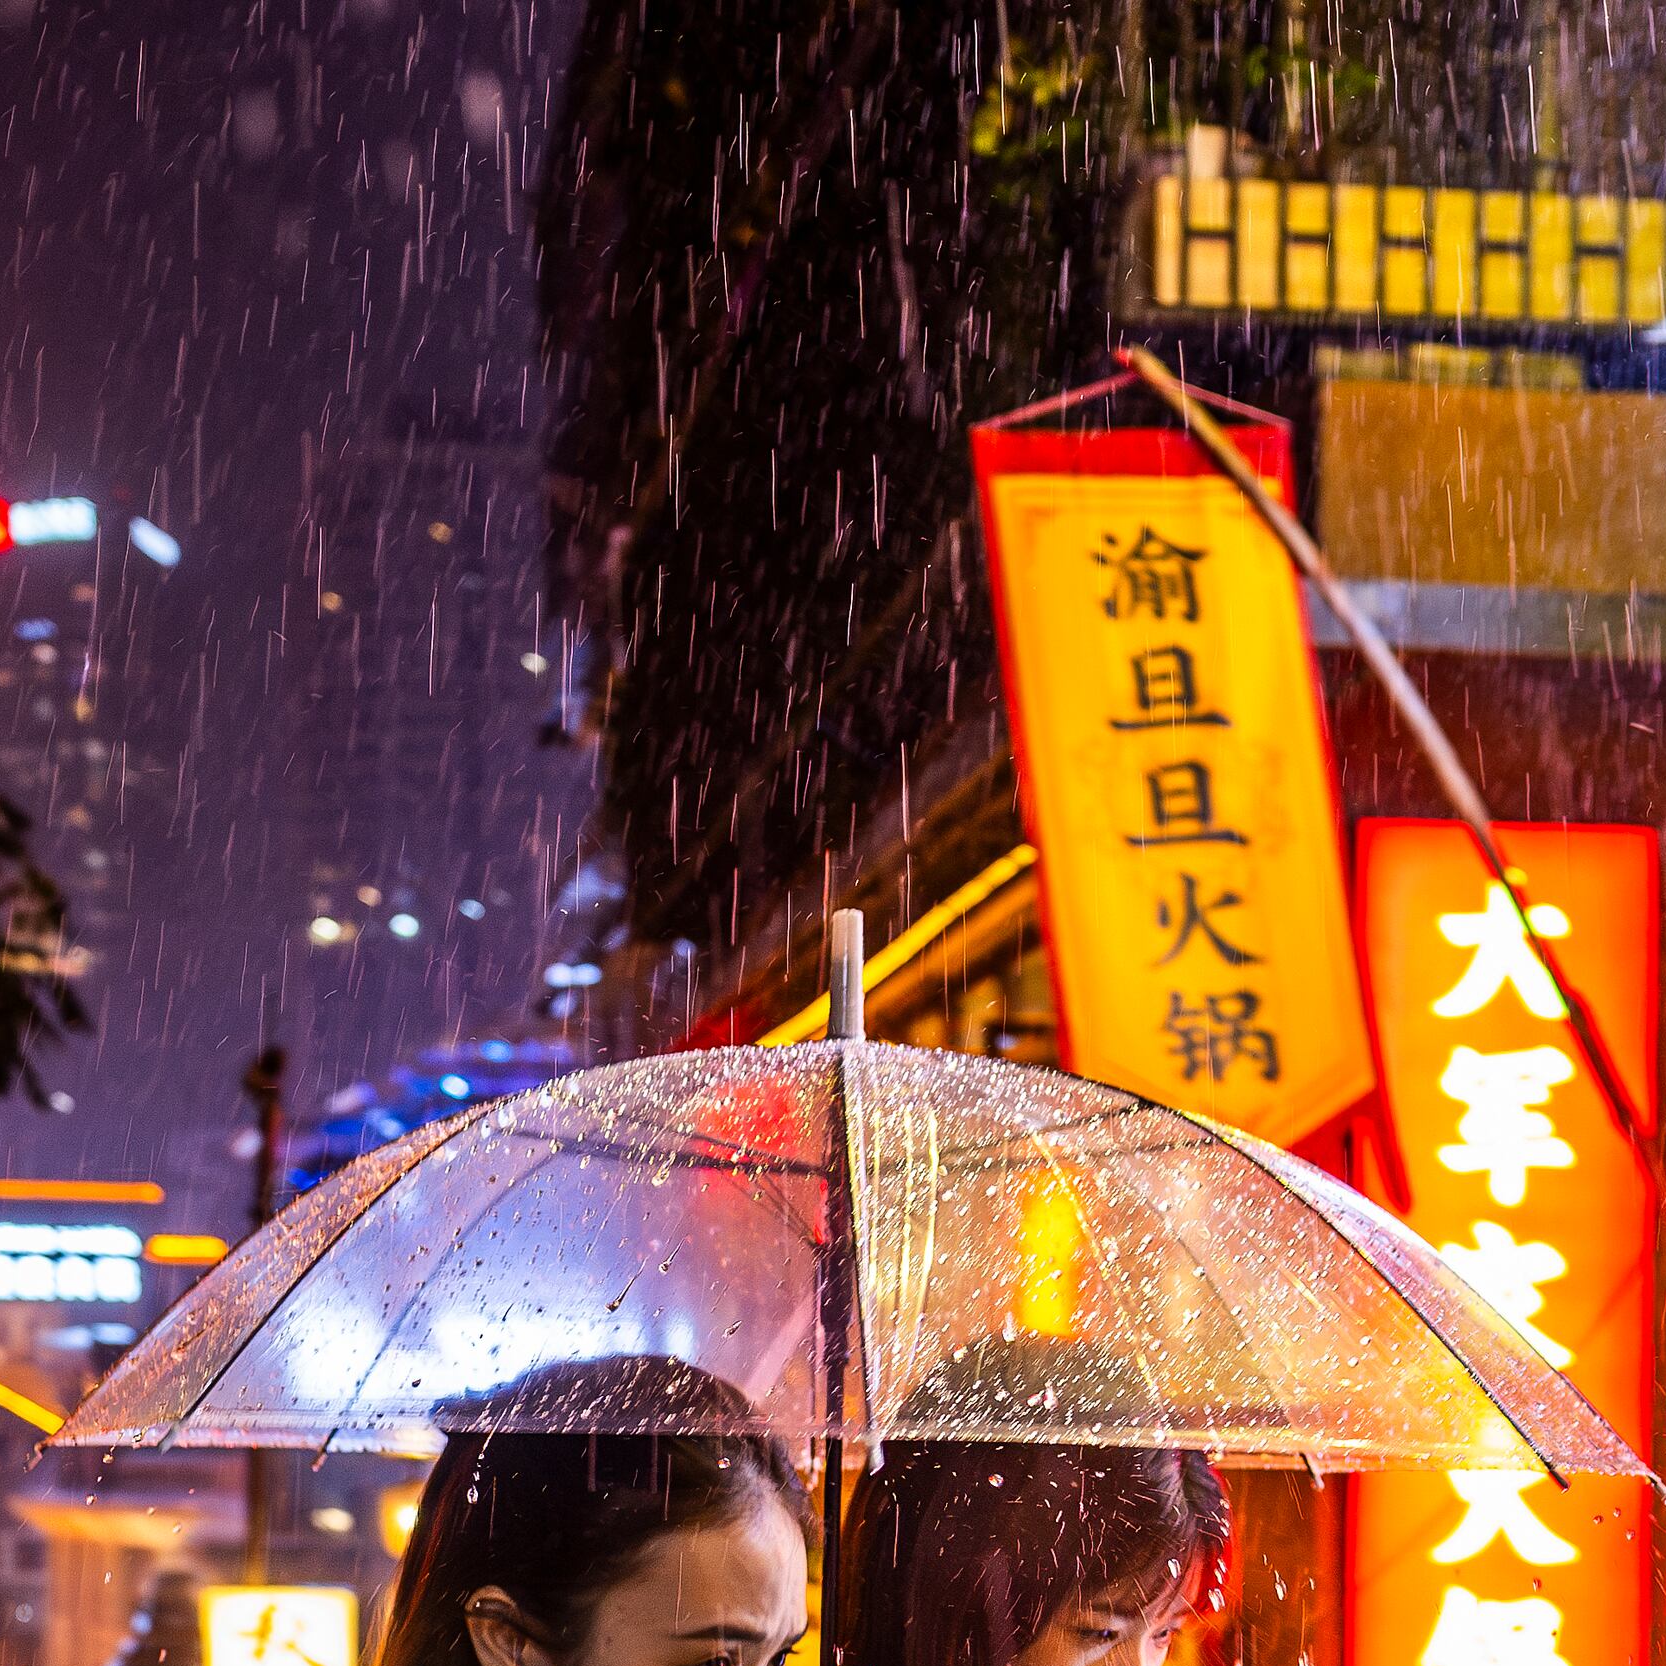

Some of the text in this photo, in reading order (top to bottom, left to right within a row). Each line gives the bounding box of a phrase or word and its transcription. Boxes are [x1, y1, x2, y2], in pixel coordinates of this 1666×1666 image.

[1089, 525, 1279, 1085] 渝旦旦火锅
